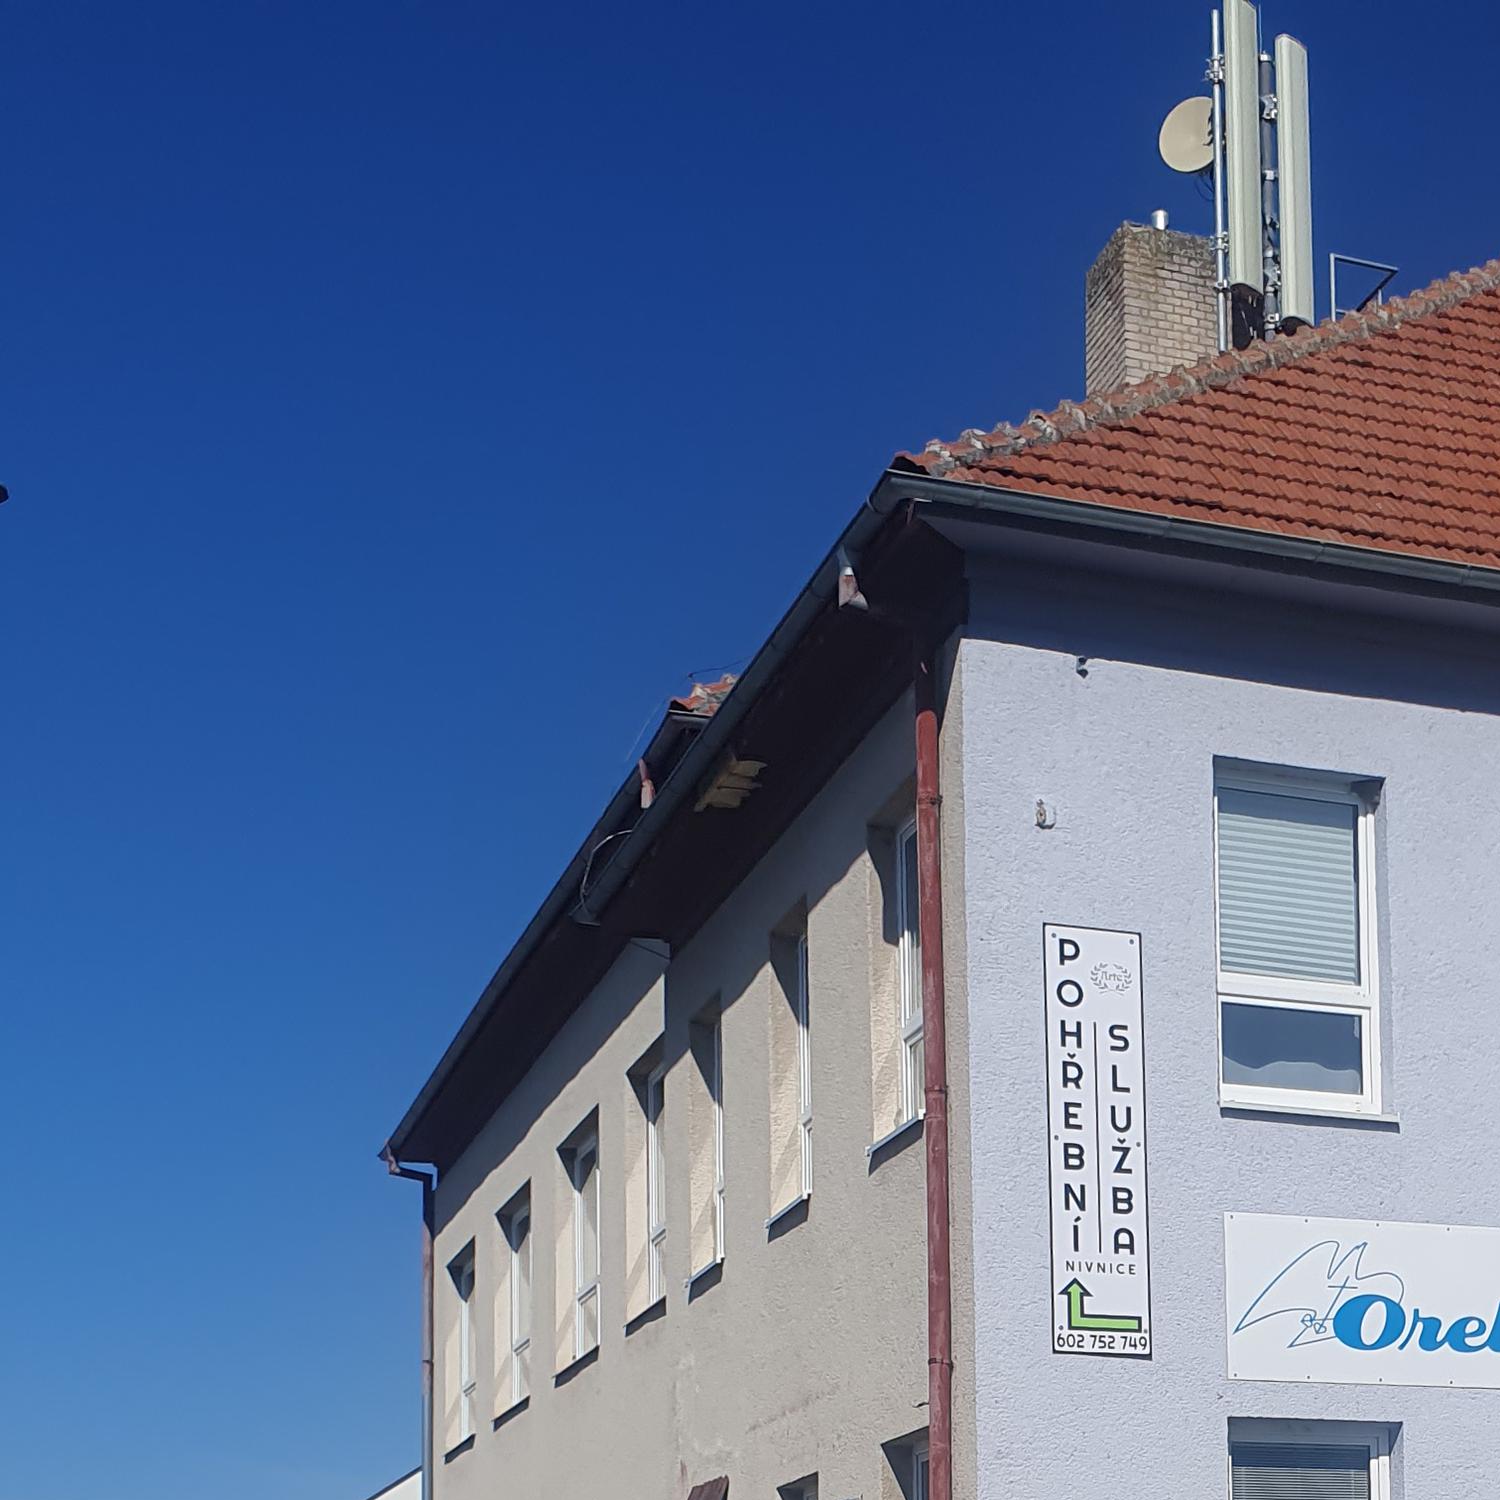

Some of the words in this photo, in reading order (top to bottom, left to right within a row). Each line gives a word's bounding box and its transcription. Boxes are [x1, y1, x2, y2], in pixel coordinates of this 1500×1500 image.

[1056, 938, 1086, 1253] POHŘEBNÍ
[1108, 1023, 1136, 1256] SLUŽBA
[1065, 1259, 1137, 1275] NIVNICE
[1056, 1334, 1085, 1349] 602
[1090, 1335, 1116, 1350] 752
[1119, 1336, 1148, 1352] 749
